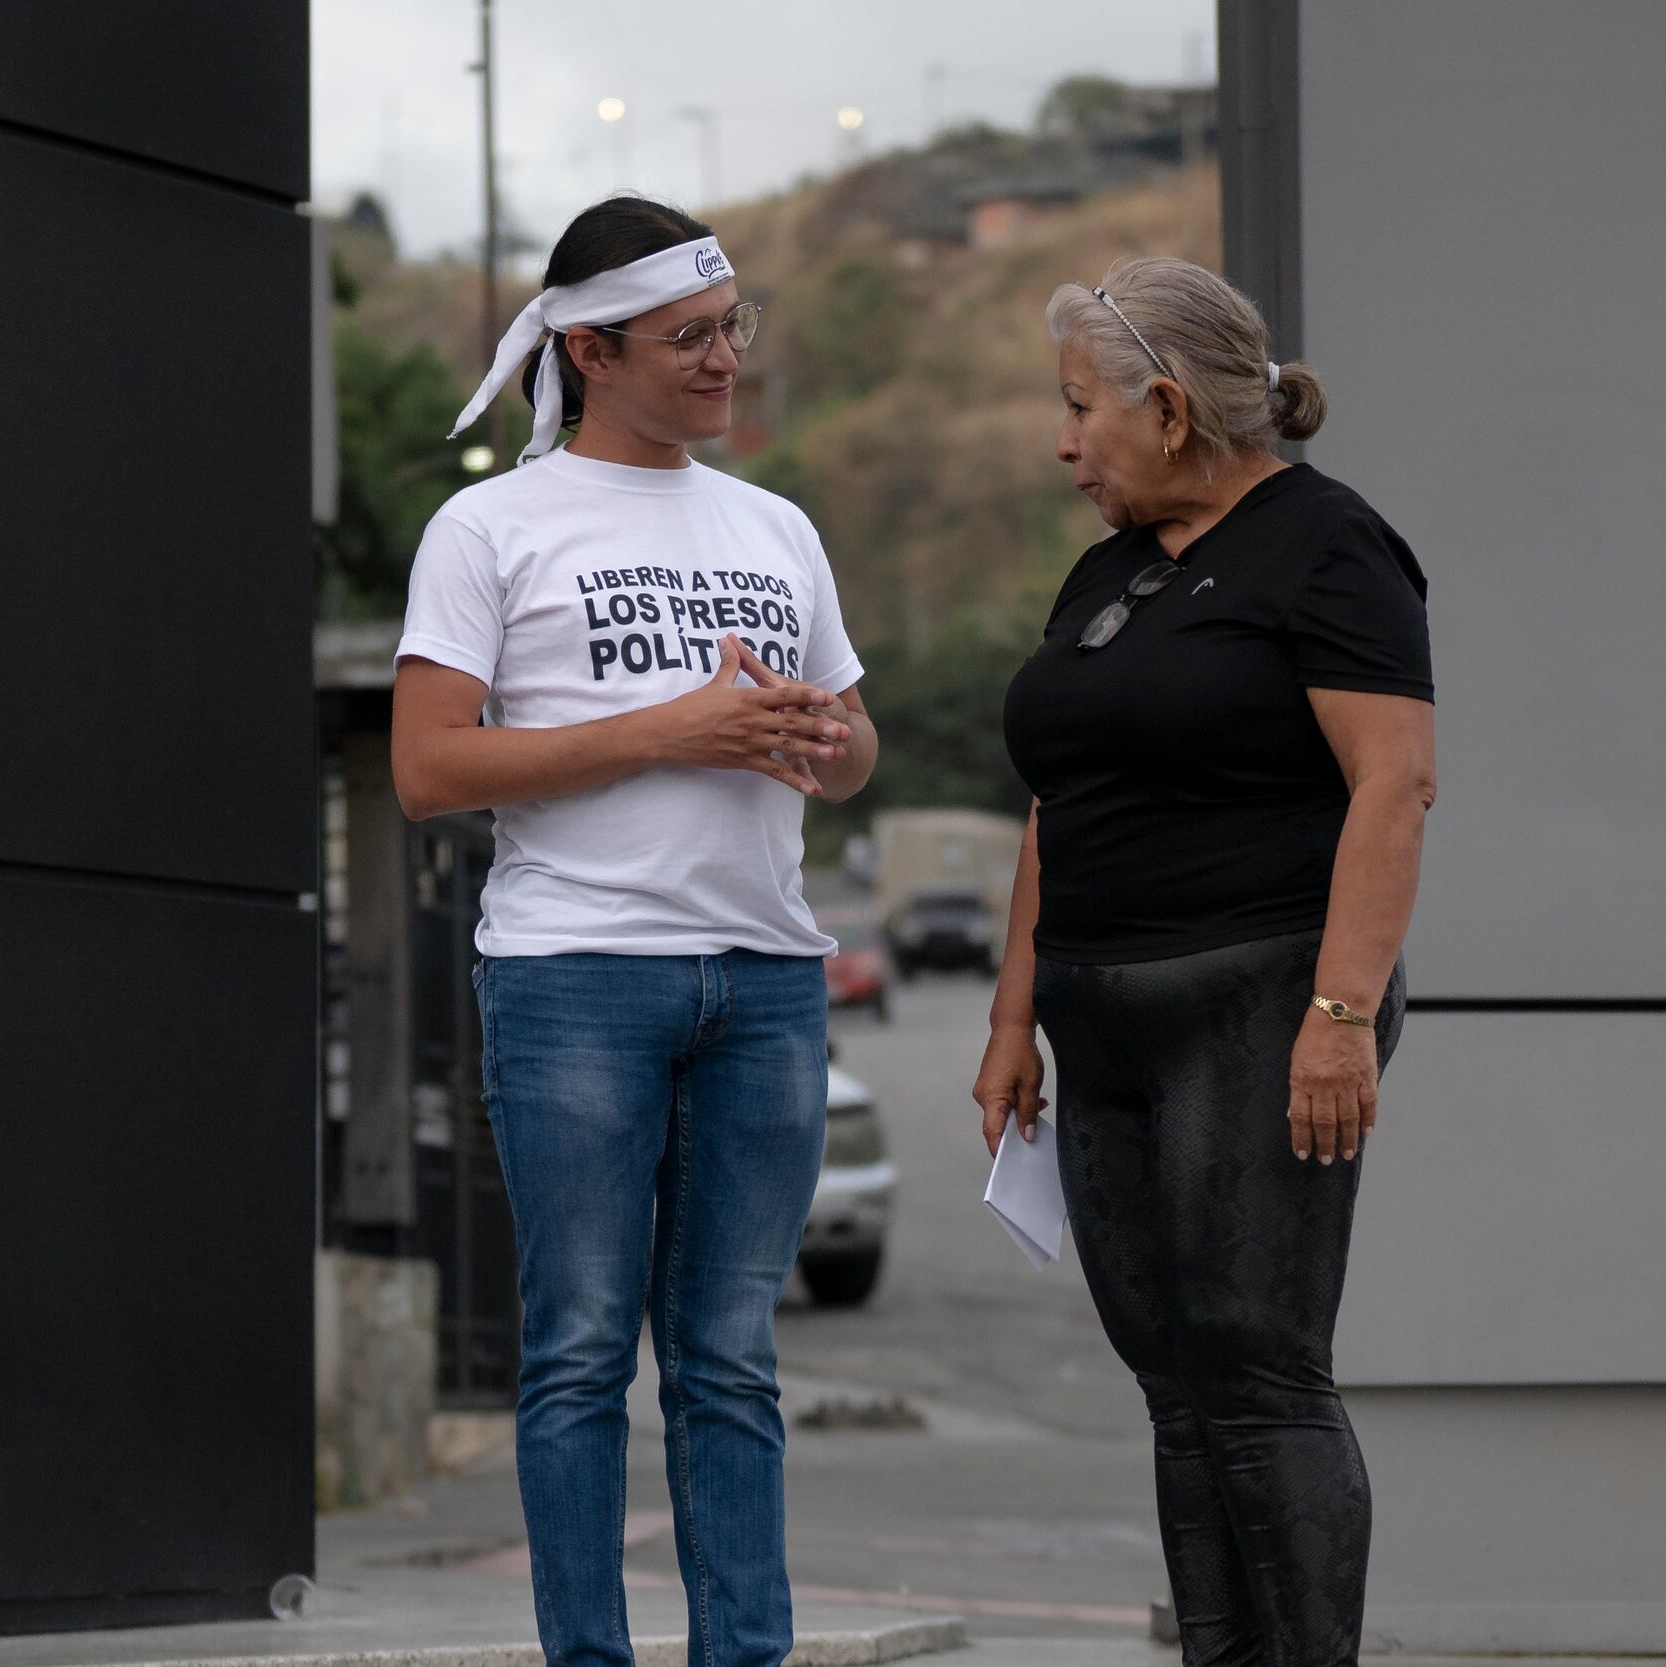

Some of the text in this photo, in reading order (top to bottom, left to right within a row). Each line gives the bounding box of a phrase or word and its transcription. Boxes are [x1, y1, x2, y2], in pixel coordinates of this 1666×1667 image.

[576, 566, 793, 600] LIBEREN A TODOS
[584, 593, 800, 638] LOS PRESOS
[589, 626, 799, 681] POLÍTOS
